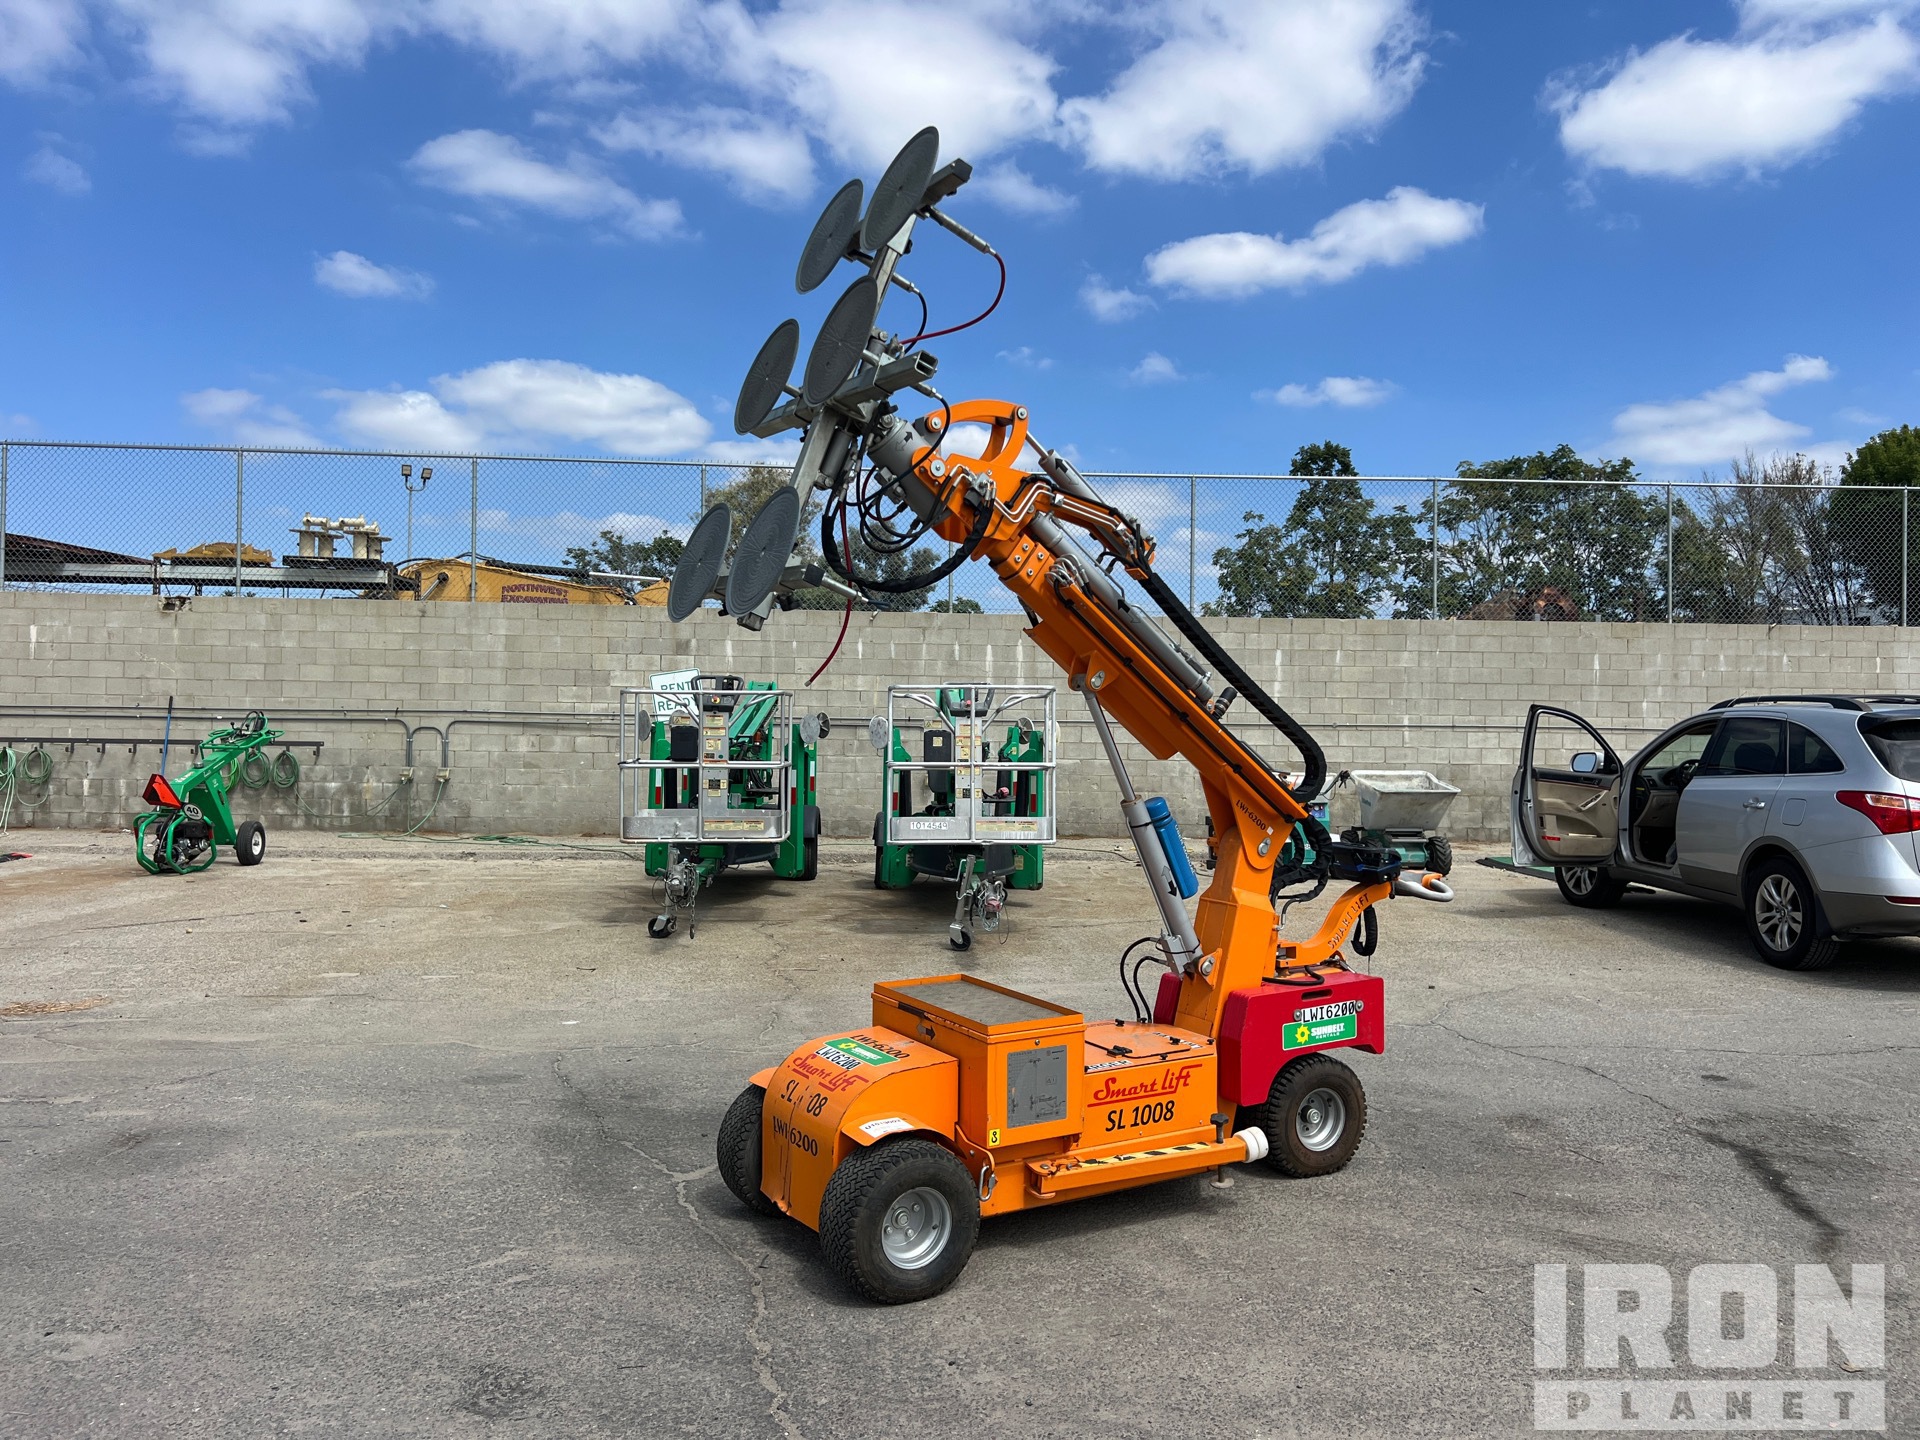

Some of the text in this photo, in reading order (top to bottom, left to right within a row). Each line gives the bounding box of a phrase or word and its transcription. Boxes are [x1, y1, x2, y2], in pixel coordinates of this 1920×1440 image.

[501, 584, 569, 597] NORTHWEST
[658, 696, 695, 711] READ
[911, 821, 948, 830] 1014549
[1236, 799, 1266, 830] LWI-6200
[1351, 892, 1369, 913] LIFT
[1302, 1001, 1355, 1023] LWI6200
[1311, 1023, 1345, 1036] SUNBELT
[792, 1053, 833, 1080] Smart
[816, 1046, 861, 1070] LWI6200
[1093, 1077, 1159, 1101] Smart
[794, 1086, 828, 1118] 08
[1105, 1100, 1175, 1132] SL 1008
